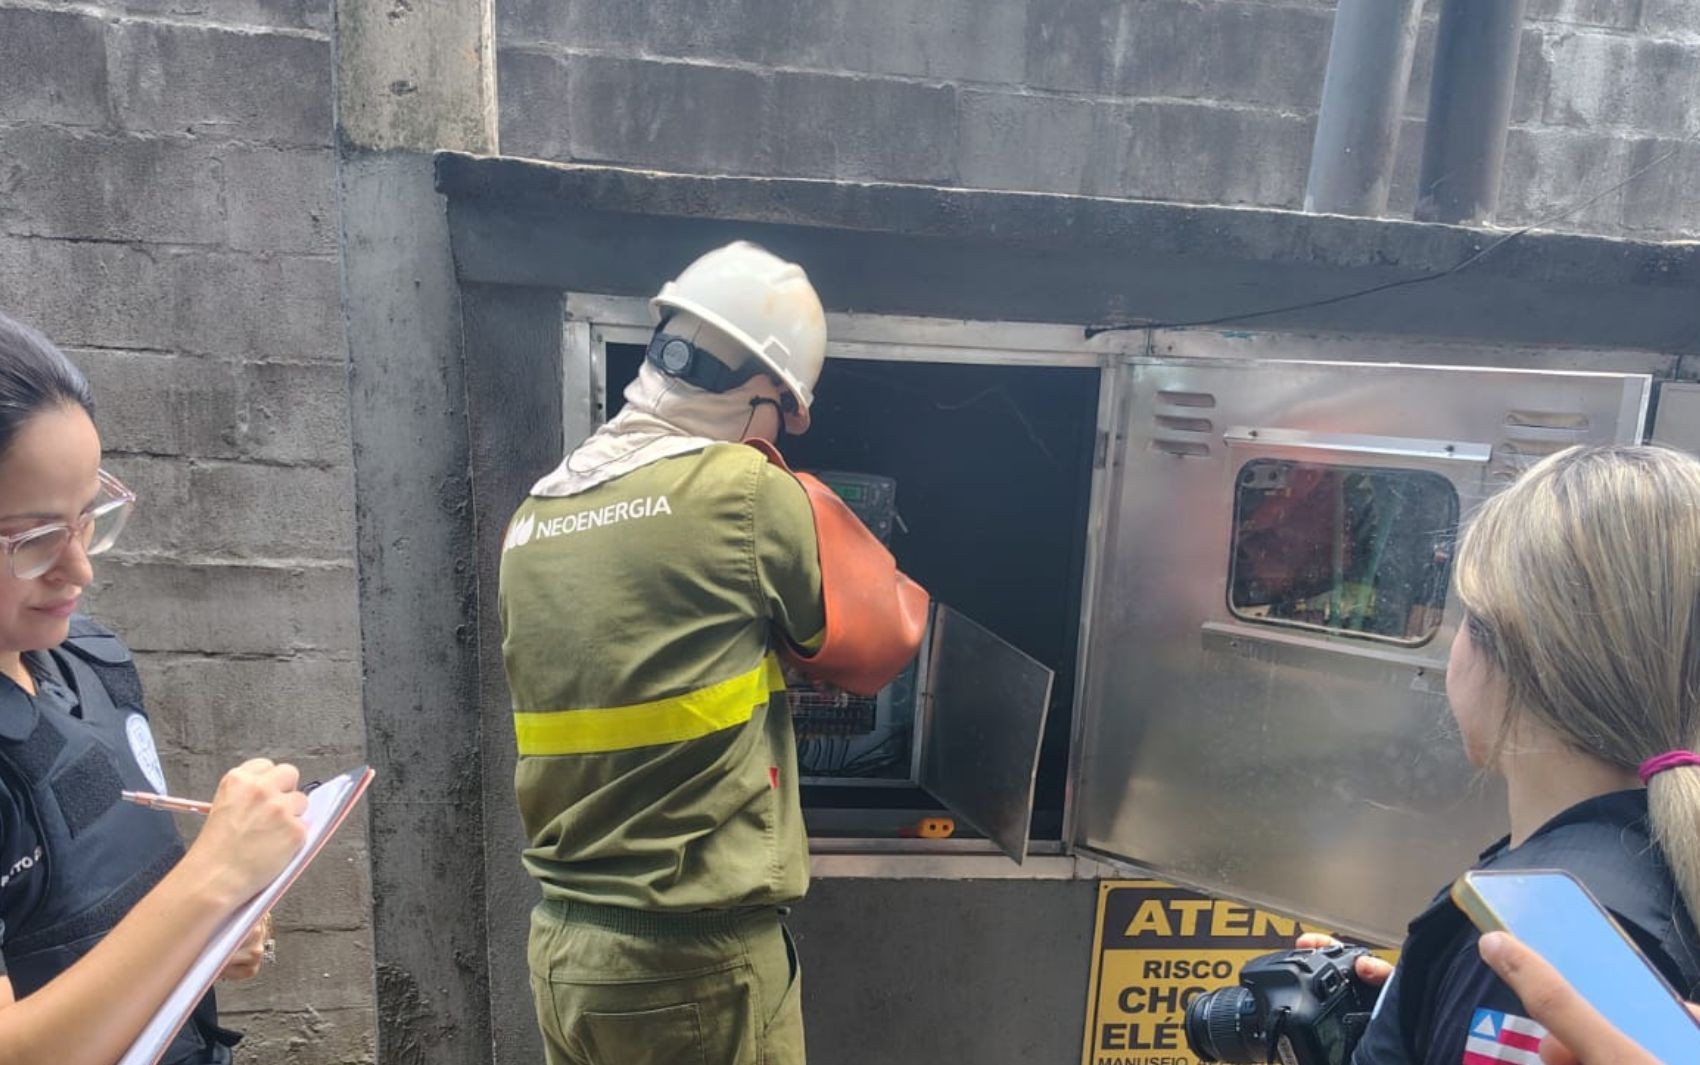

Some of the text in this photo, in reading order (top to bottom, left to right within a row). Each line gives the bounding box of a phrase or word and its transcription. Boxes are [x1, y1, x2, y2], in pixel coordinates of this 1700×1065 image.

[536, 496, 672, 540] NEOENERGIA
[1124, 900, 1302, 936] ATEN
[1143, 960, 1232, 979] RISCO
[1101, 1018, 1187, 1050] ELÉ
